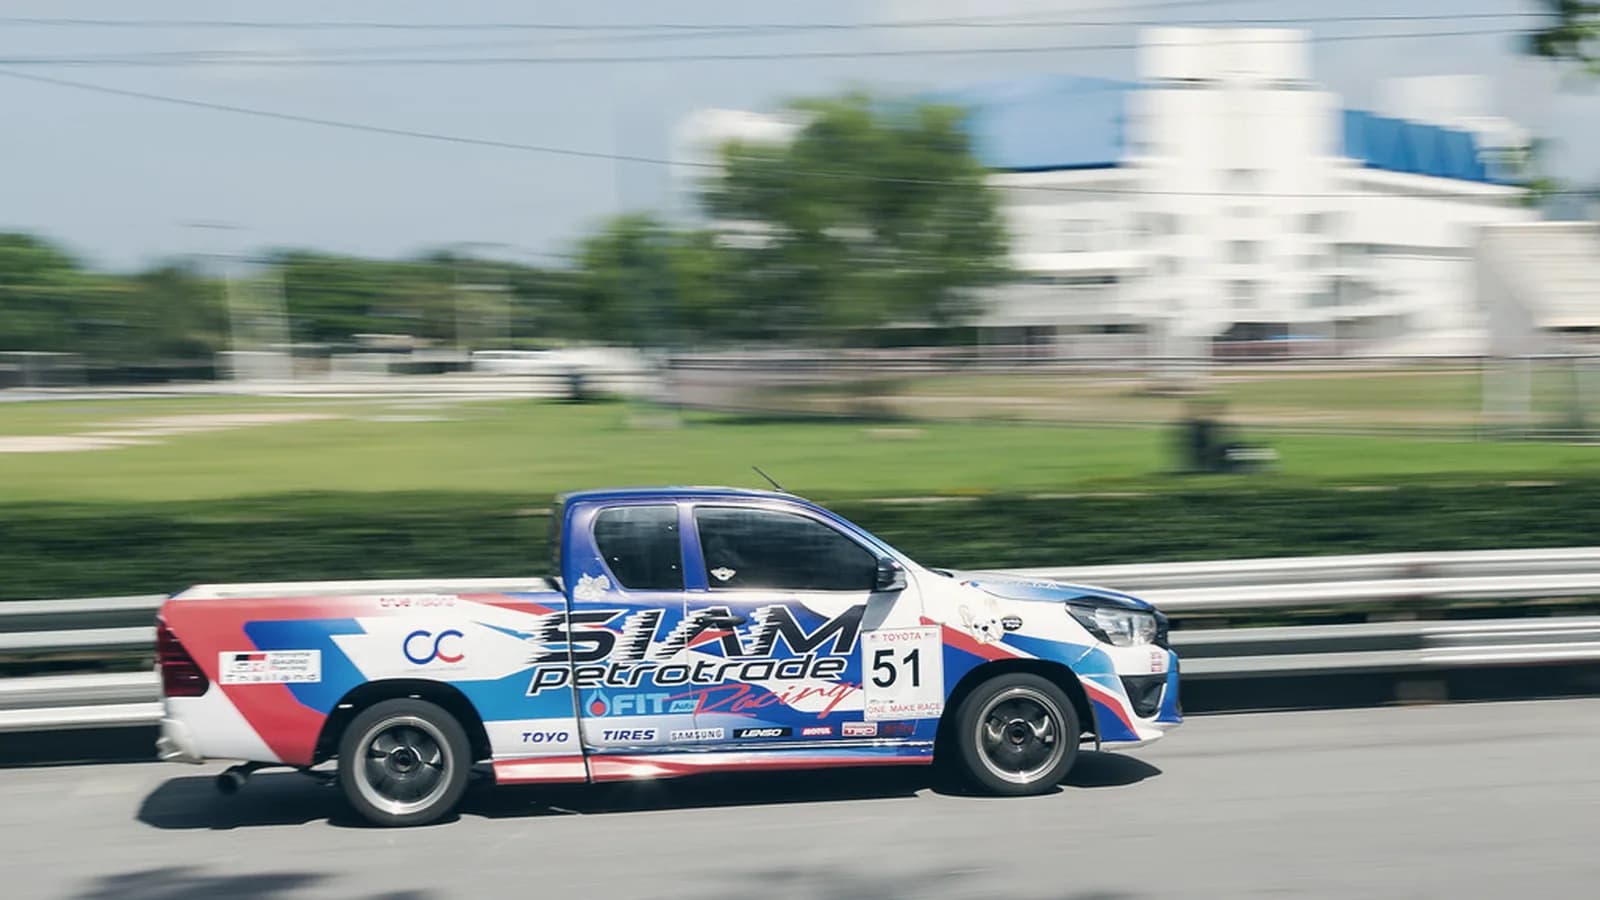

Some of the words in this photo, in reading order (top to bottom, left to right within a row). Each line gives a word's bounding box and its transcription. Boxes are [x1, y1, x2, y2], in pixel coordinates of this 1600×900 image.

[527, 605, 866, 663] SIAM
[882, 632, 921, 641] TOYOTA
[526, 653, 848, 695] petrotrade
[872, 648, 920, 688] 51
[612, 693, 670, 715] FIT
[867, 705, 886, 714] ONE
[889, 704, 916, 712] MAKE
[917, 703, 942, 711] RACE
[522, 732, 569, 743] TOYO
[603, 730, 656, 741] TIRES
[671, 730, 724, 741] SAMSUNG
[740, 729, 784, 738] LENSO
